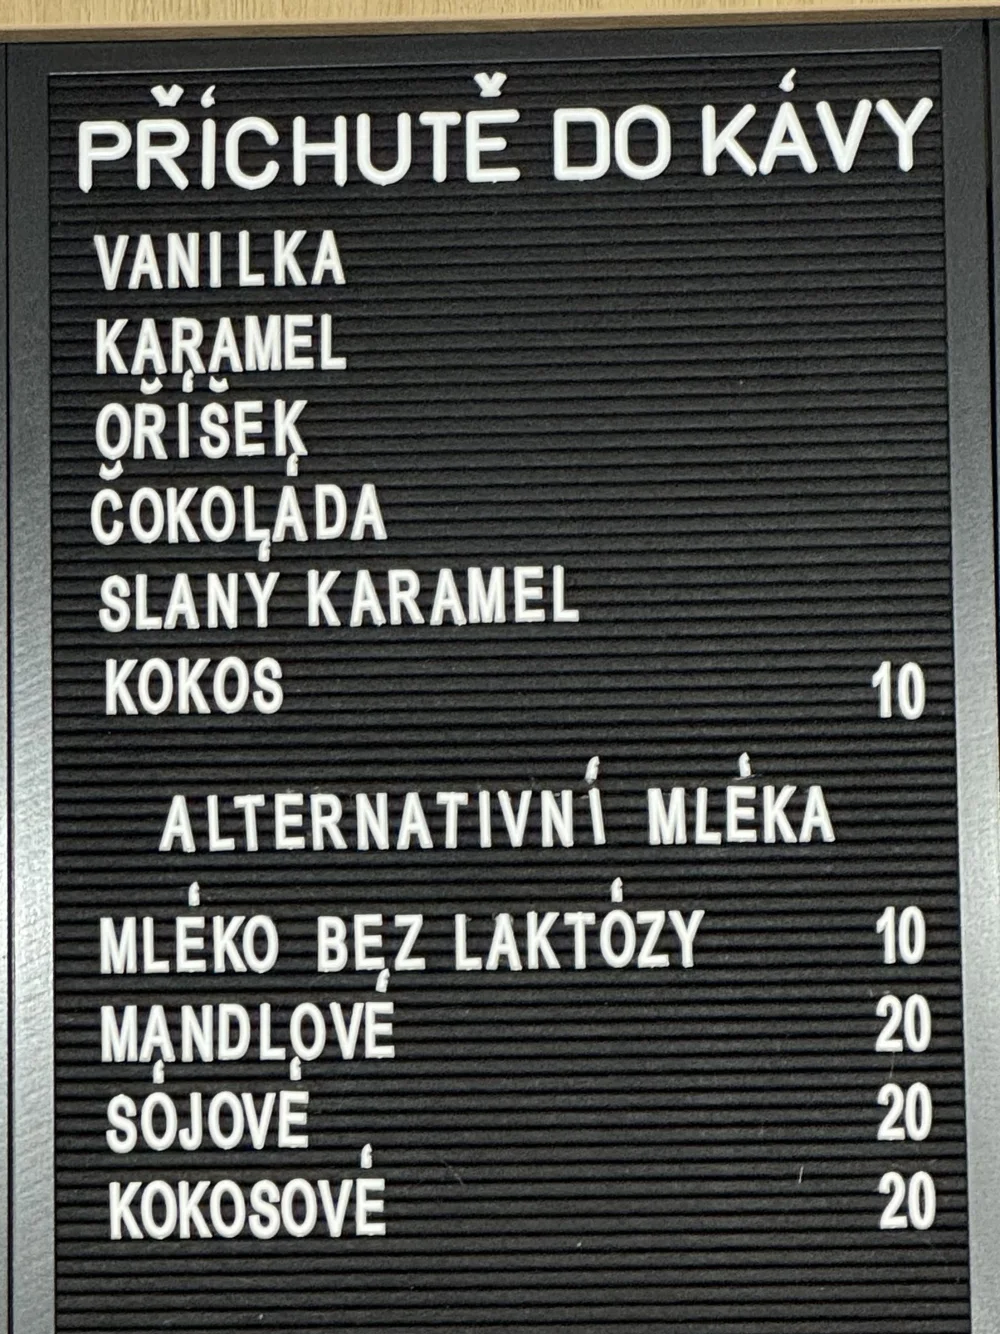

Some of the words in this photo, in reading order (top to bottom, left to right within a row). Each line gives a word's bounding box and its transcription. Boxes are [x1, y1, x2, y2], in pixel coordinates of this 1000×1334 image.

[78, 71, 521, 194] PŘÍCHUTĚ
[553, 103, 672, 182] DO
[701, 67, 934, 177] KÁVY
[93, 229, 346, 291] VANILKA
[96, 313, 347, 376] KARAMEL
[95, 368, 309, 461] OŘÍŠEK
[90, 454, 388, 546] ČOKOLÁDA
[98, 541, 281, 633] SLANÝ
[307, 564, 580, 628] KARAMEL
[105, 655, 284, 716] KOKOS
[871, 660, 926, 720] 10
[158, 755, 607, 853] ALTERNATIVNÍ
[647, 751, 836, 846] MLÉKA
[99, 881, 279, 974] MLÉKO
[317, 913, 426, 973] BEZ
[454, 876, 706, 972] LAKTÓZY
[875, 905, 926, 965] 10
[100, 967, 396, 1063] MANDLOVÉ
[874, 993, 932, 1053] 20
[105, 1055, 310, 1154] SÓJOVÉ
[876, 1081, 933, 1141] 20
[108, 1143, 387, 1240] KOKOSOVÉ
[877, 1170, 937, 1230] 20
